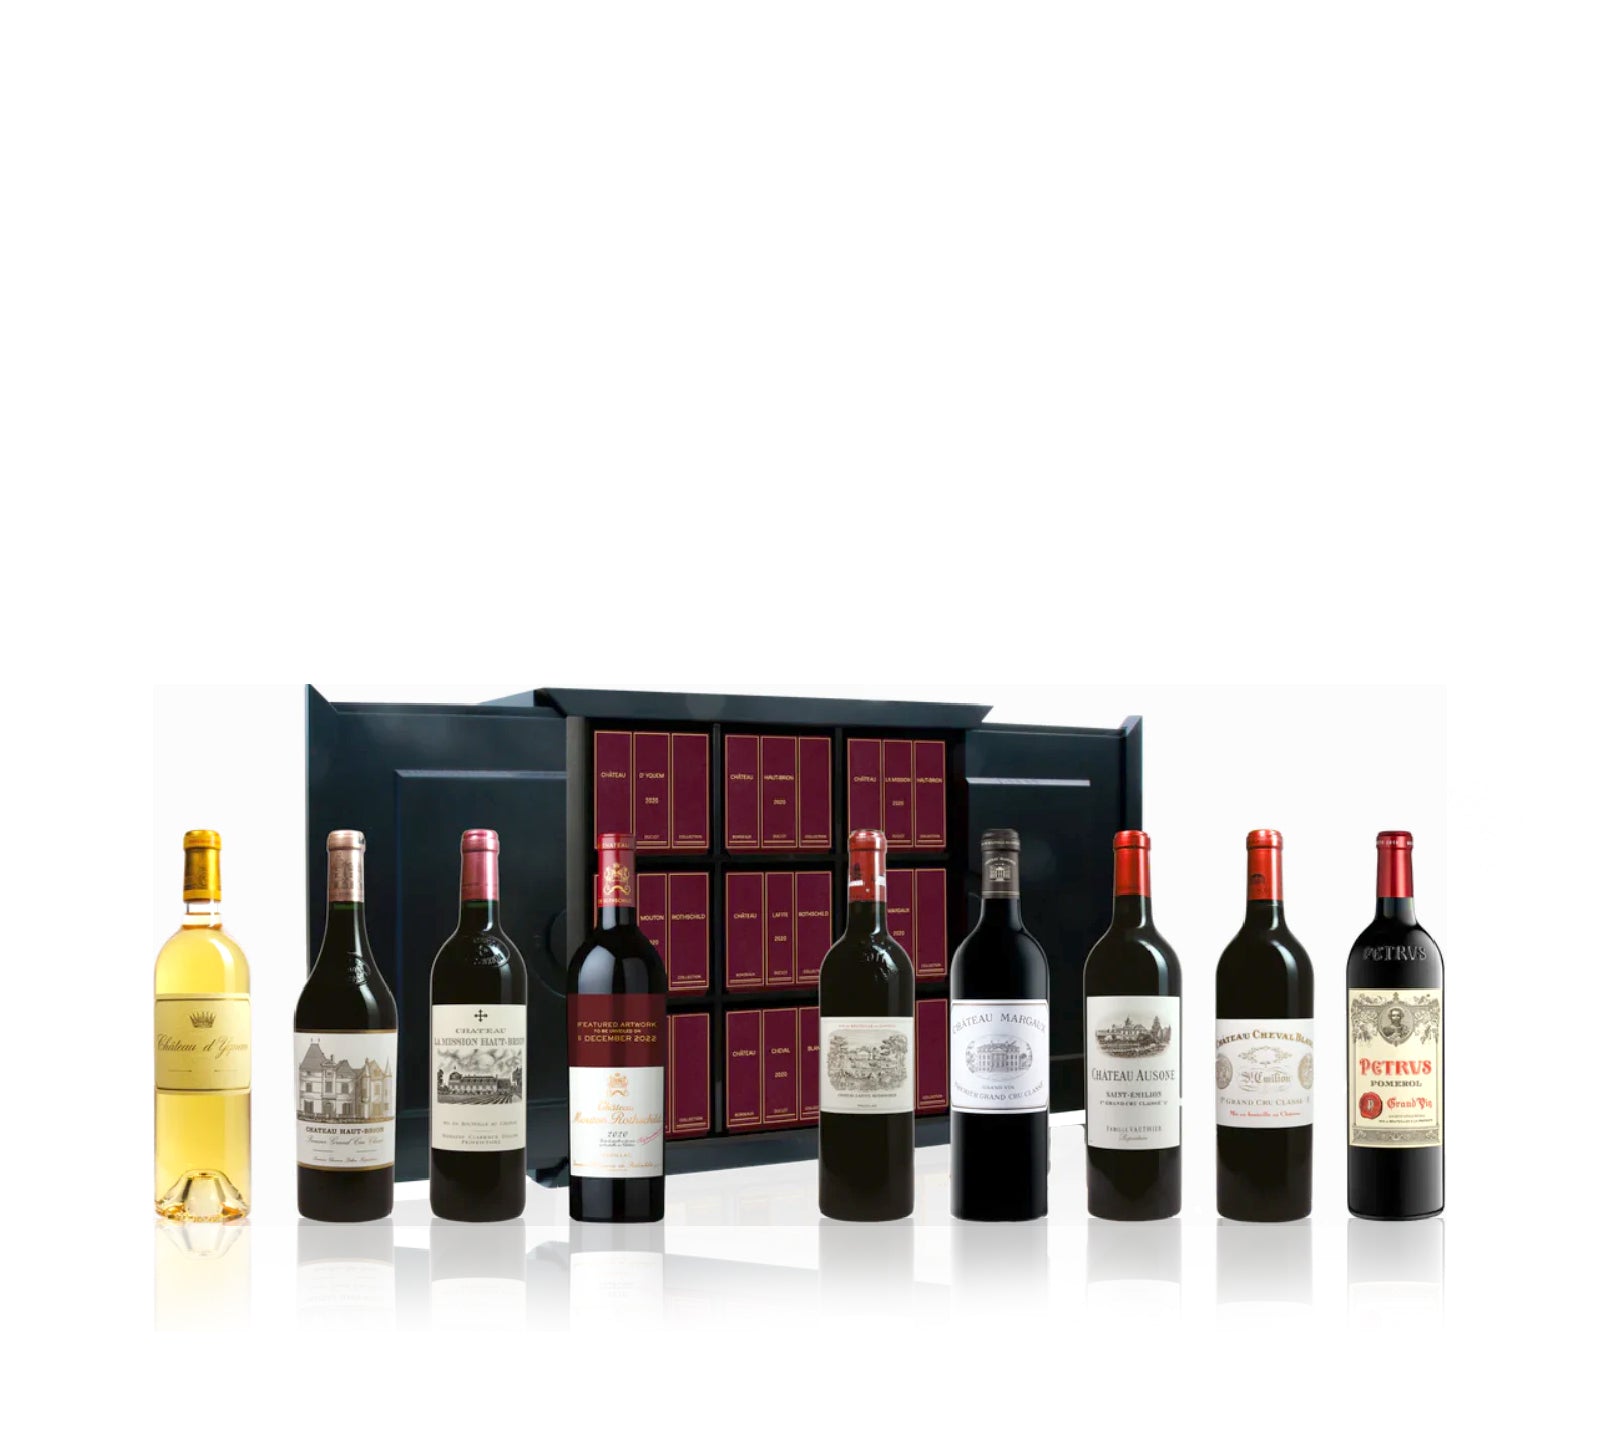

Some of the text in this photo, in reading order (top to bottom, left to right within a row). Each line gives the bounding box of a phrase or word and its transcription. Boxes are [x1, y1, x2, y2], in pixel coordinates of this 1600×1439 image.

[1000, 1013, 1045, 1032] MARGAUX
[584, 1034, 633, 1042] DECEMBER
[634, 1034, 656, 1042] 2022
